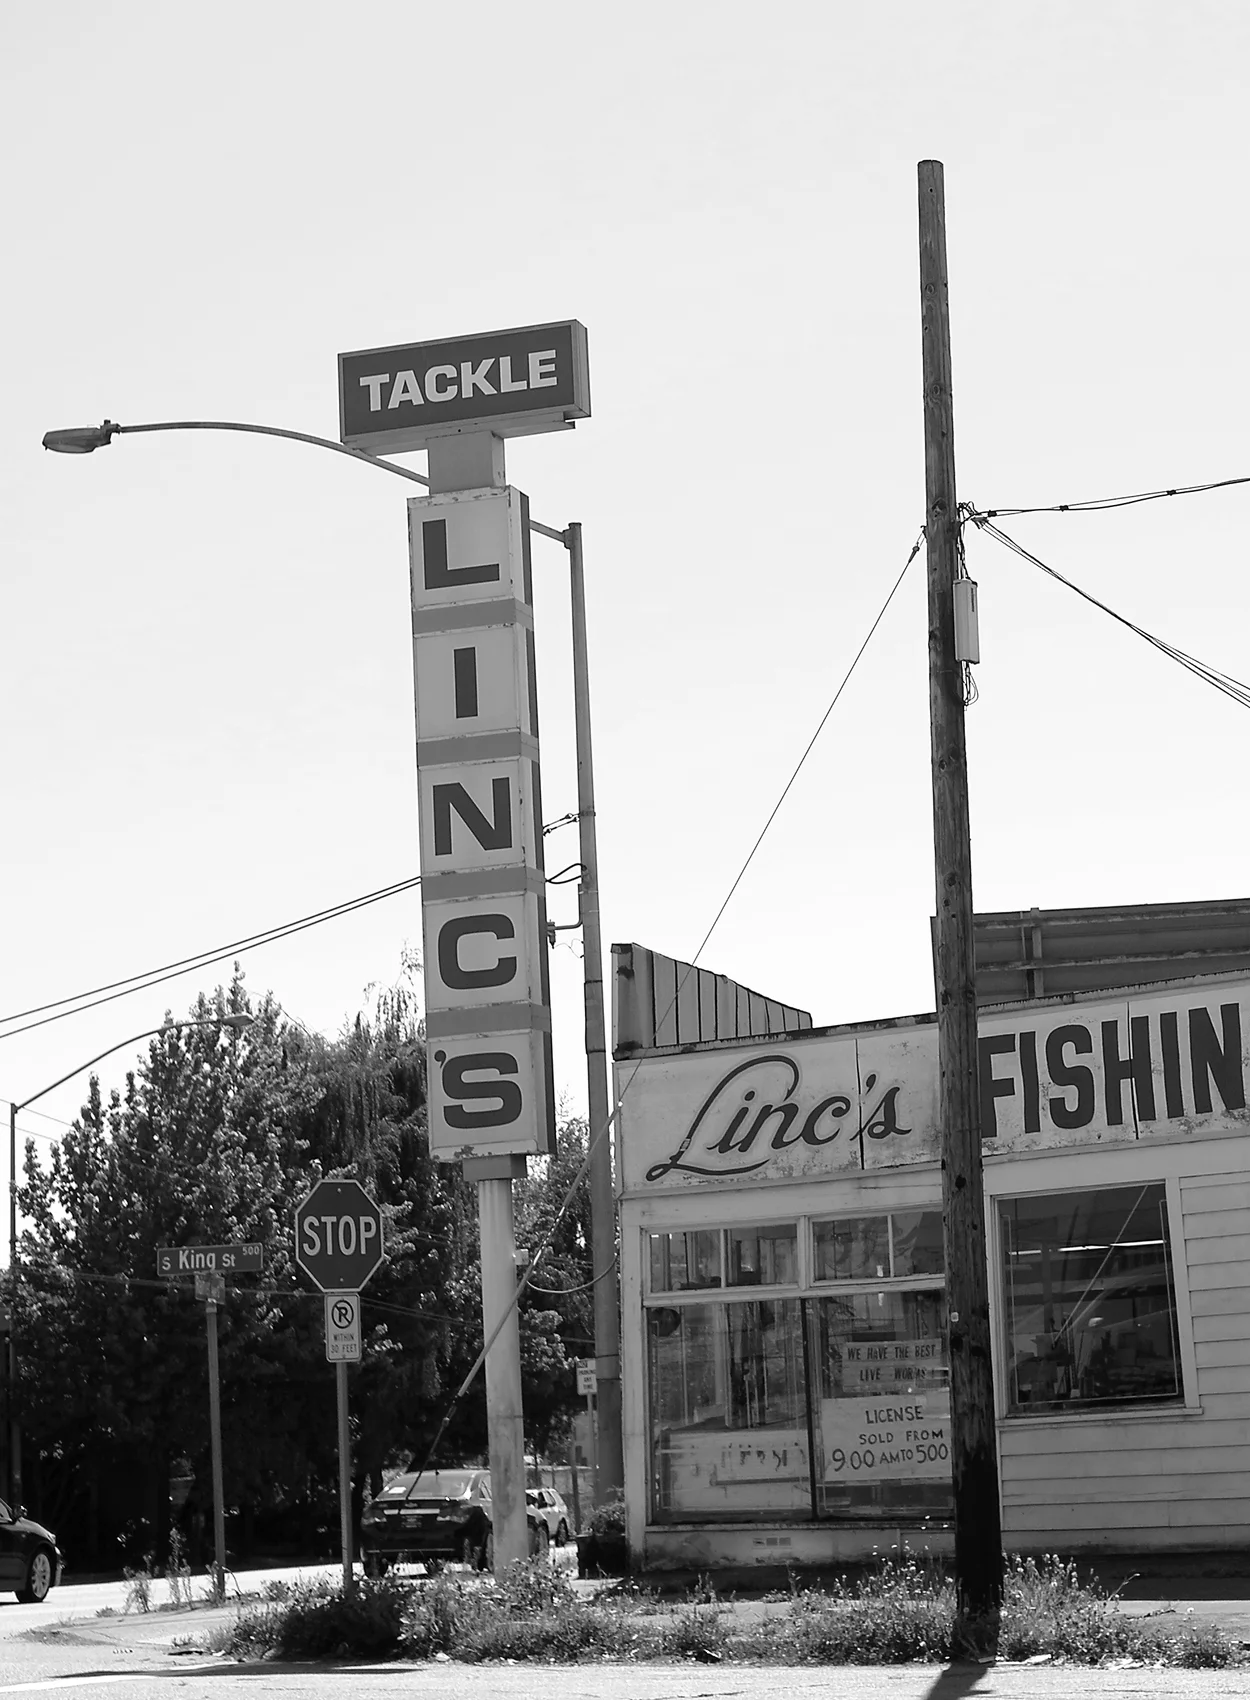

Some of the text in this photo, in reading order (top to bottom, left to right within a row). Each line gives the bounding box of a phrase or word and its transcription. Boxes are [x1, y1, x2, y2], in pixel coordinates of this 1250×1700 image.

[359, 348, 559, 413] TACKLE
[645, 1054, 913, 1182] Linc's
[302, 1215, 377, 1257] STOP
[242, 1245, 260, 1256] 500
[162, 1249, 236, 1274] S King St
[342, 1343, 357, 1353] FEET
[847, 1344, 936, 1360] WE HAVE THE BEST
[860, 1367, 881, 1382] LIVE
[865, 1404, 924, 1424] LICENSE
[858, 1428, 944, 1445] SOLD FROM
